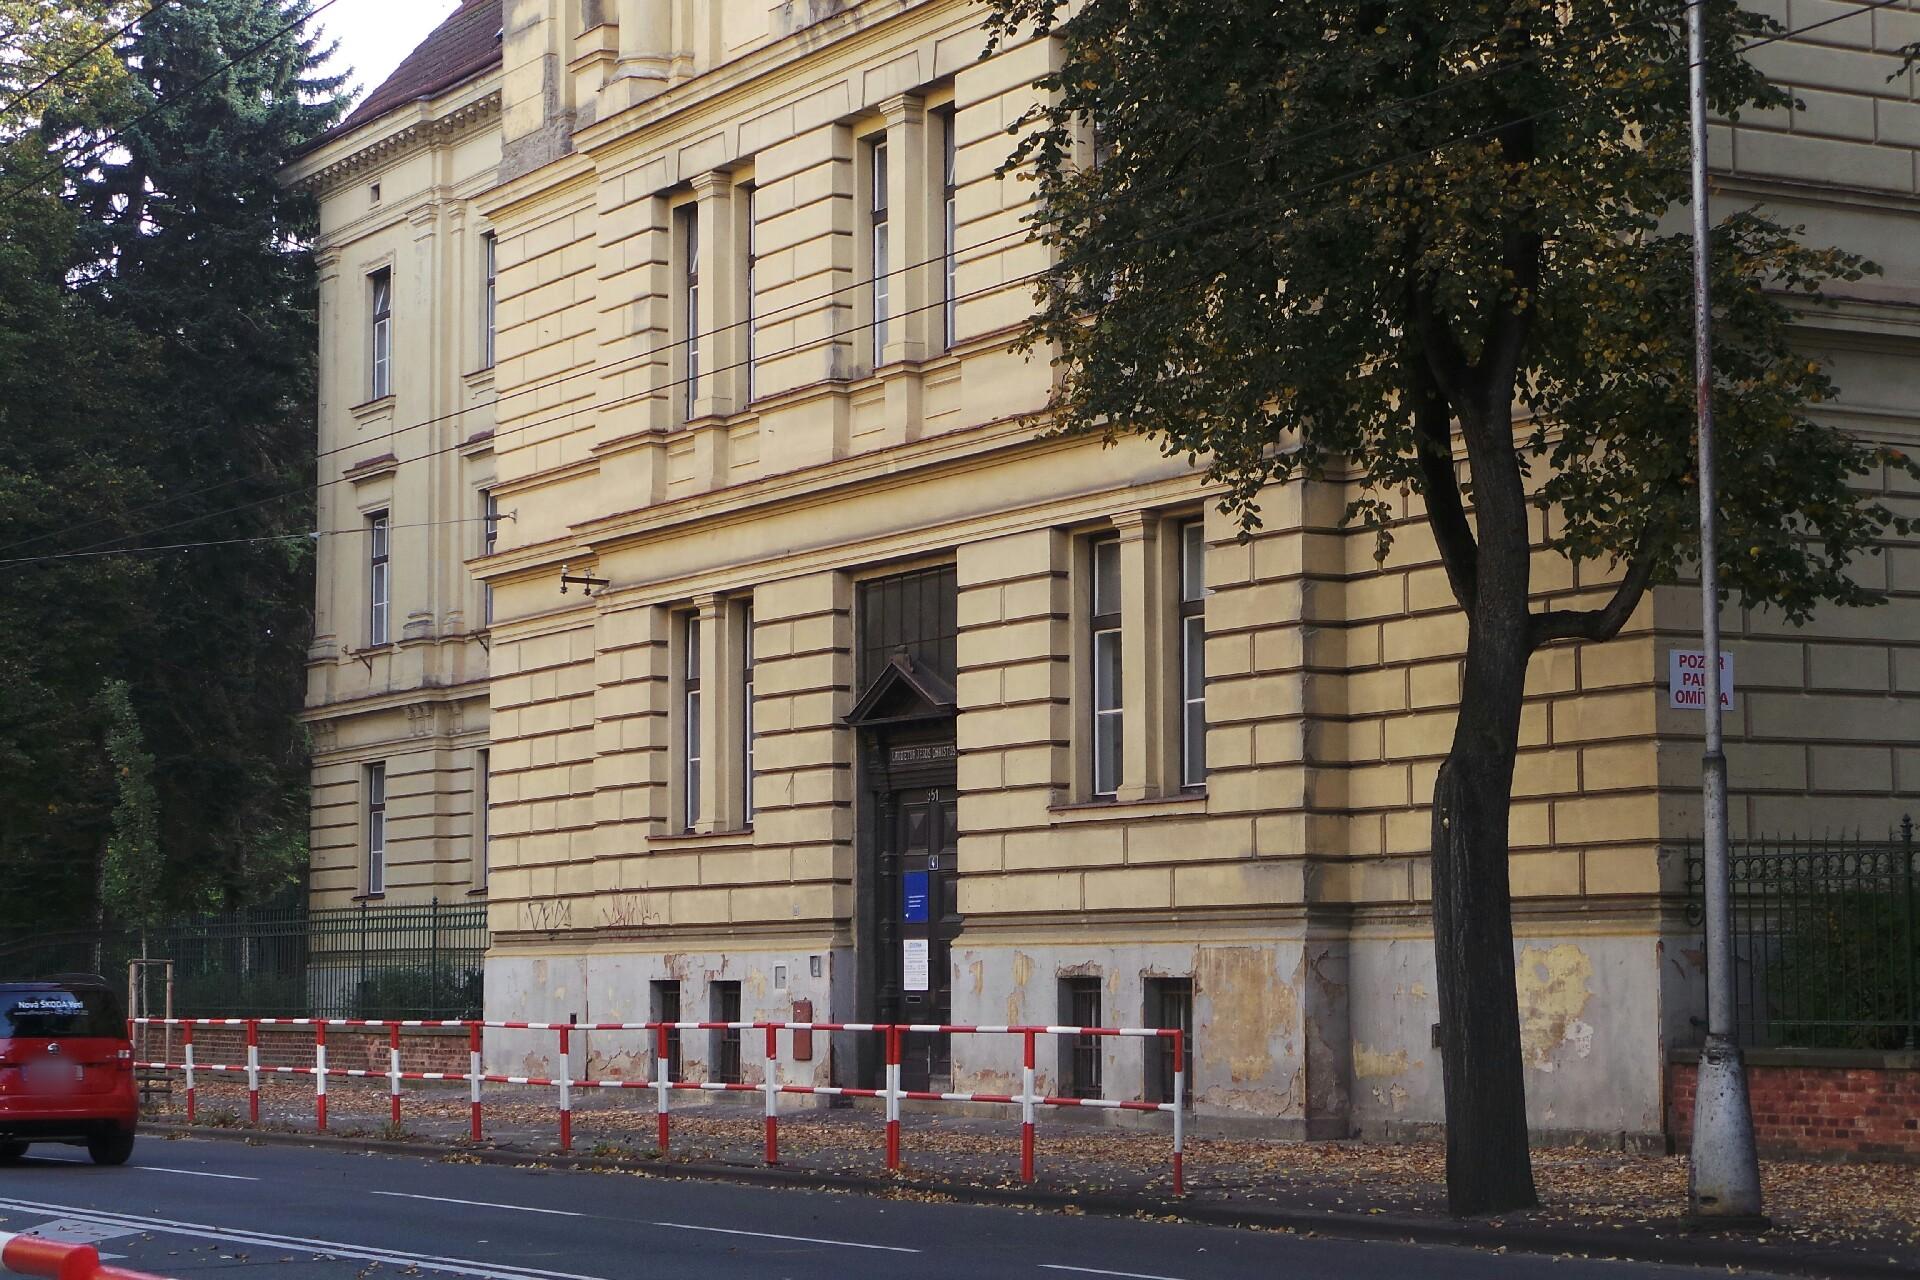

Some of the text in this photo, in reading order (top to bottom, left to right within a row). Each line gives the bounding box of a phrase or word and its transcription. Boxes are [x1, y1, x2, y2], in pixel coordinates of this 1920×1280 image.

[1679, 654, 1725, 670] POZR
[1675, 688, 1729, 706] OMÍTA
[18, 999, 84, 1009] Nová ŠKODA Yeti
